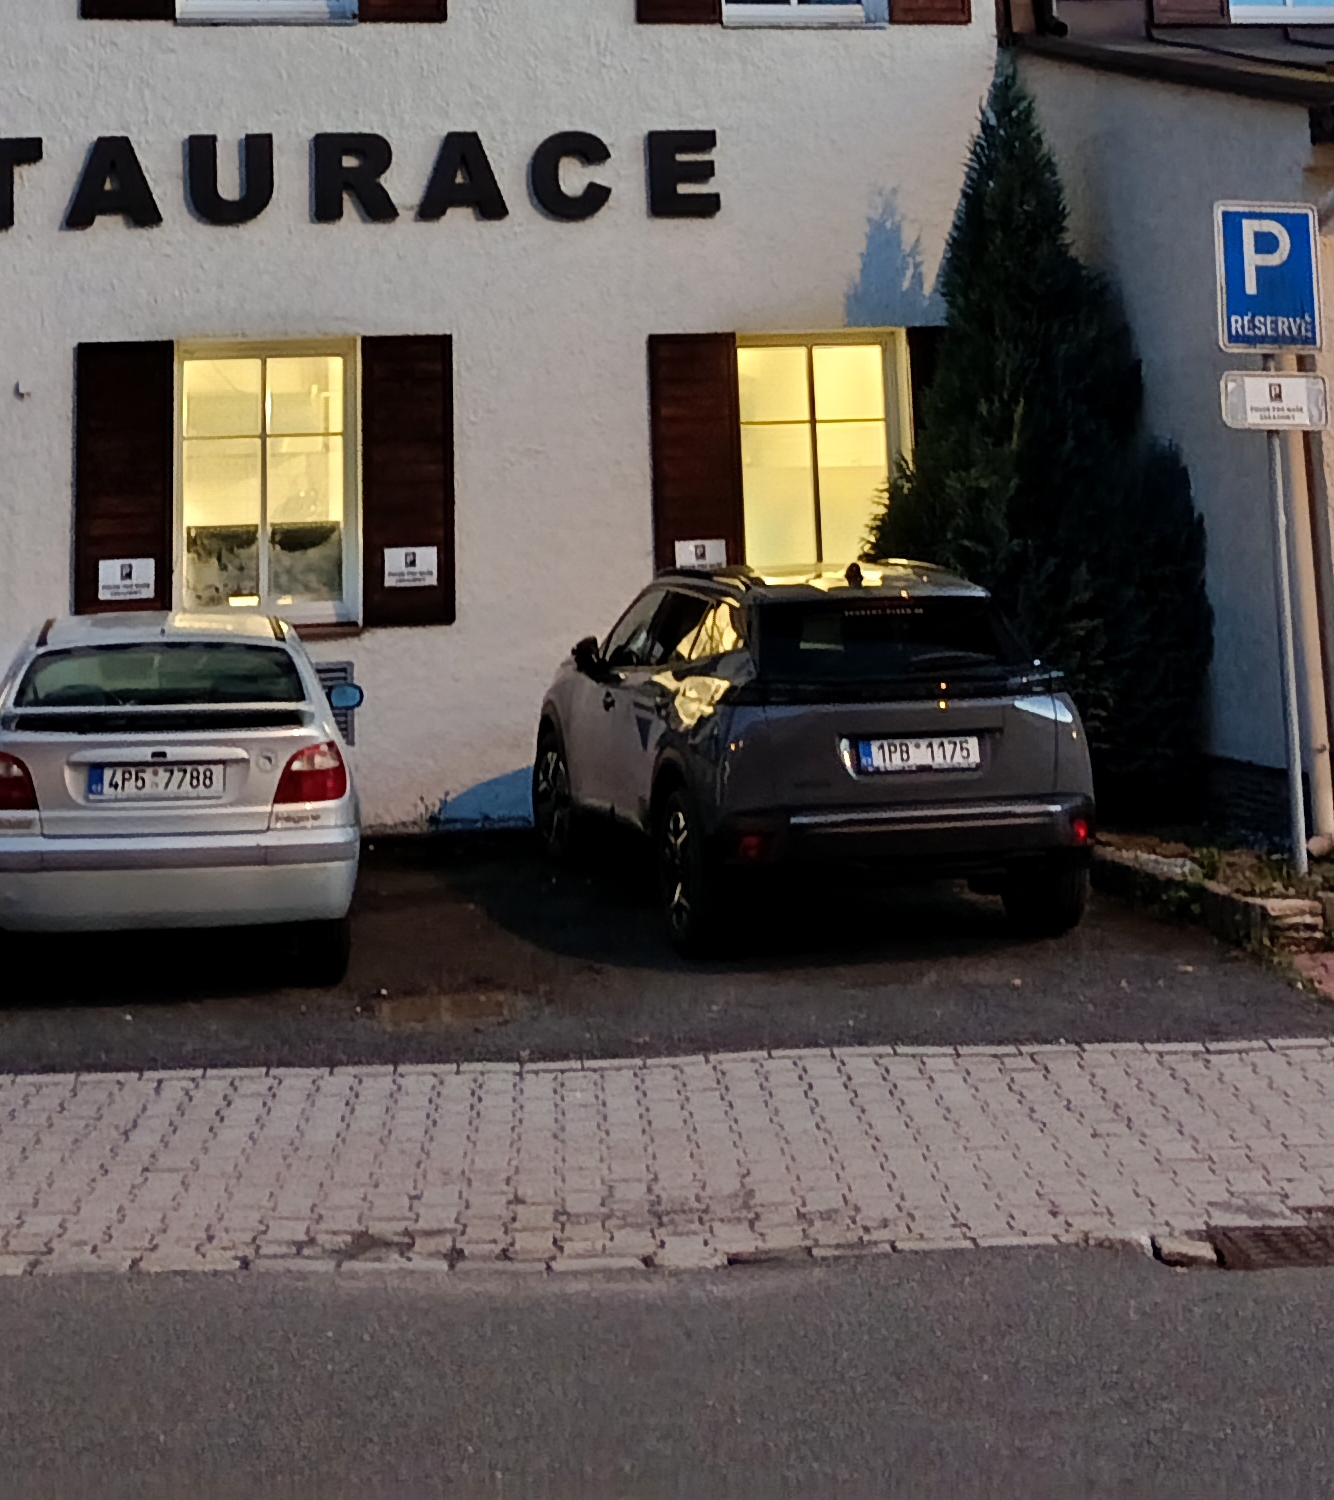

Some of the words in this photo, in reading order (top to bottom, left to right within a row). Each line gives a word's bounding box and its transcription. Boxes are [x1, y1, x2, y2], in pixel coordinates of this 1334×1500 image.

[1242, 218, 1291, 295] P
[925, 739, 971, 762] 1175
[163, 766, 215, 791] 7788
